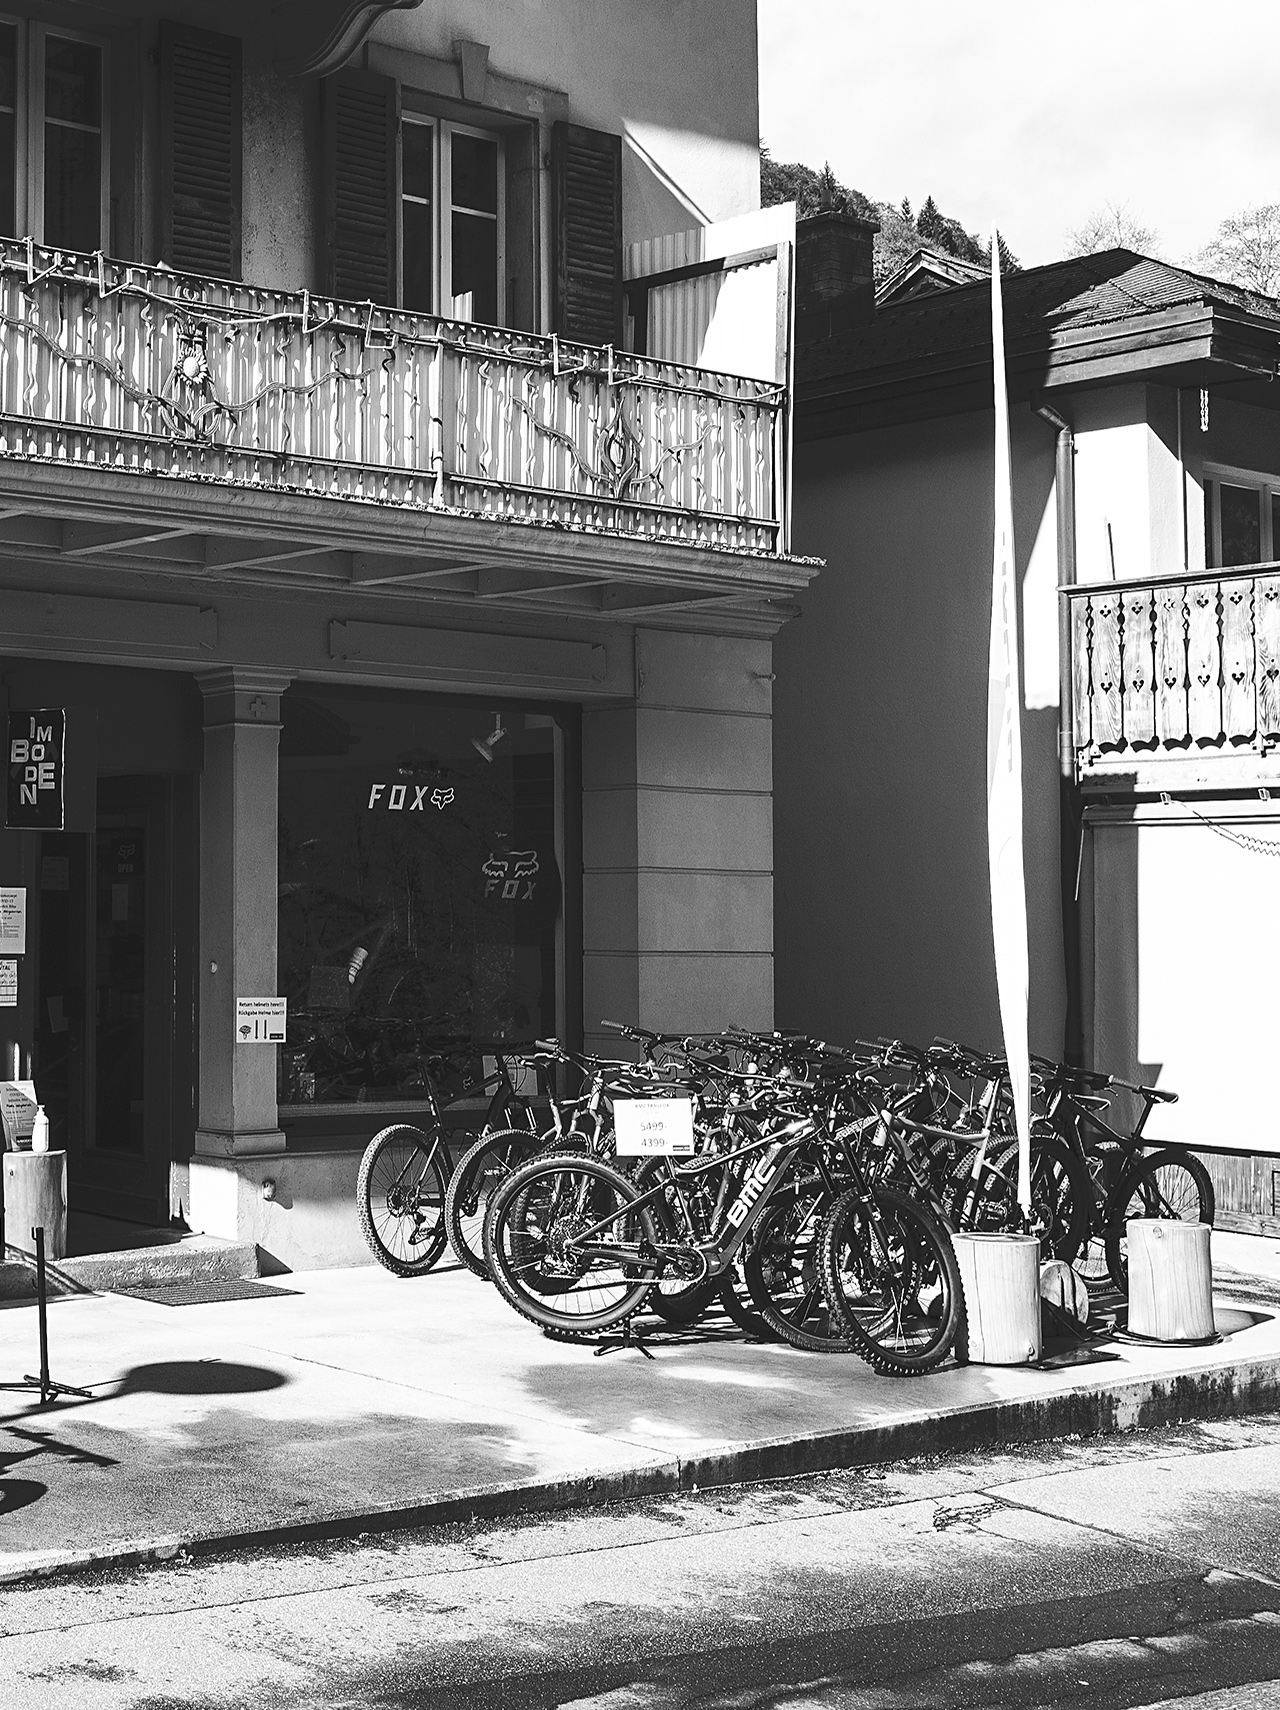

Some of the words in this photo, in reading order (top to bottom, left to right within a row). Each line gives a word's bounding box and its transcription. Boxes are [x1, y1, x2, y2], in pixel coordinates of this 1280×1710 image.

[368, 784, 428, 811] FOX
[484, 880, 537, 901] FOX
[726, 1155, 777, 1228] BMC
